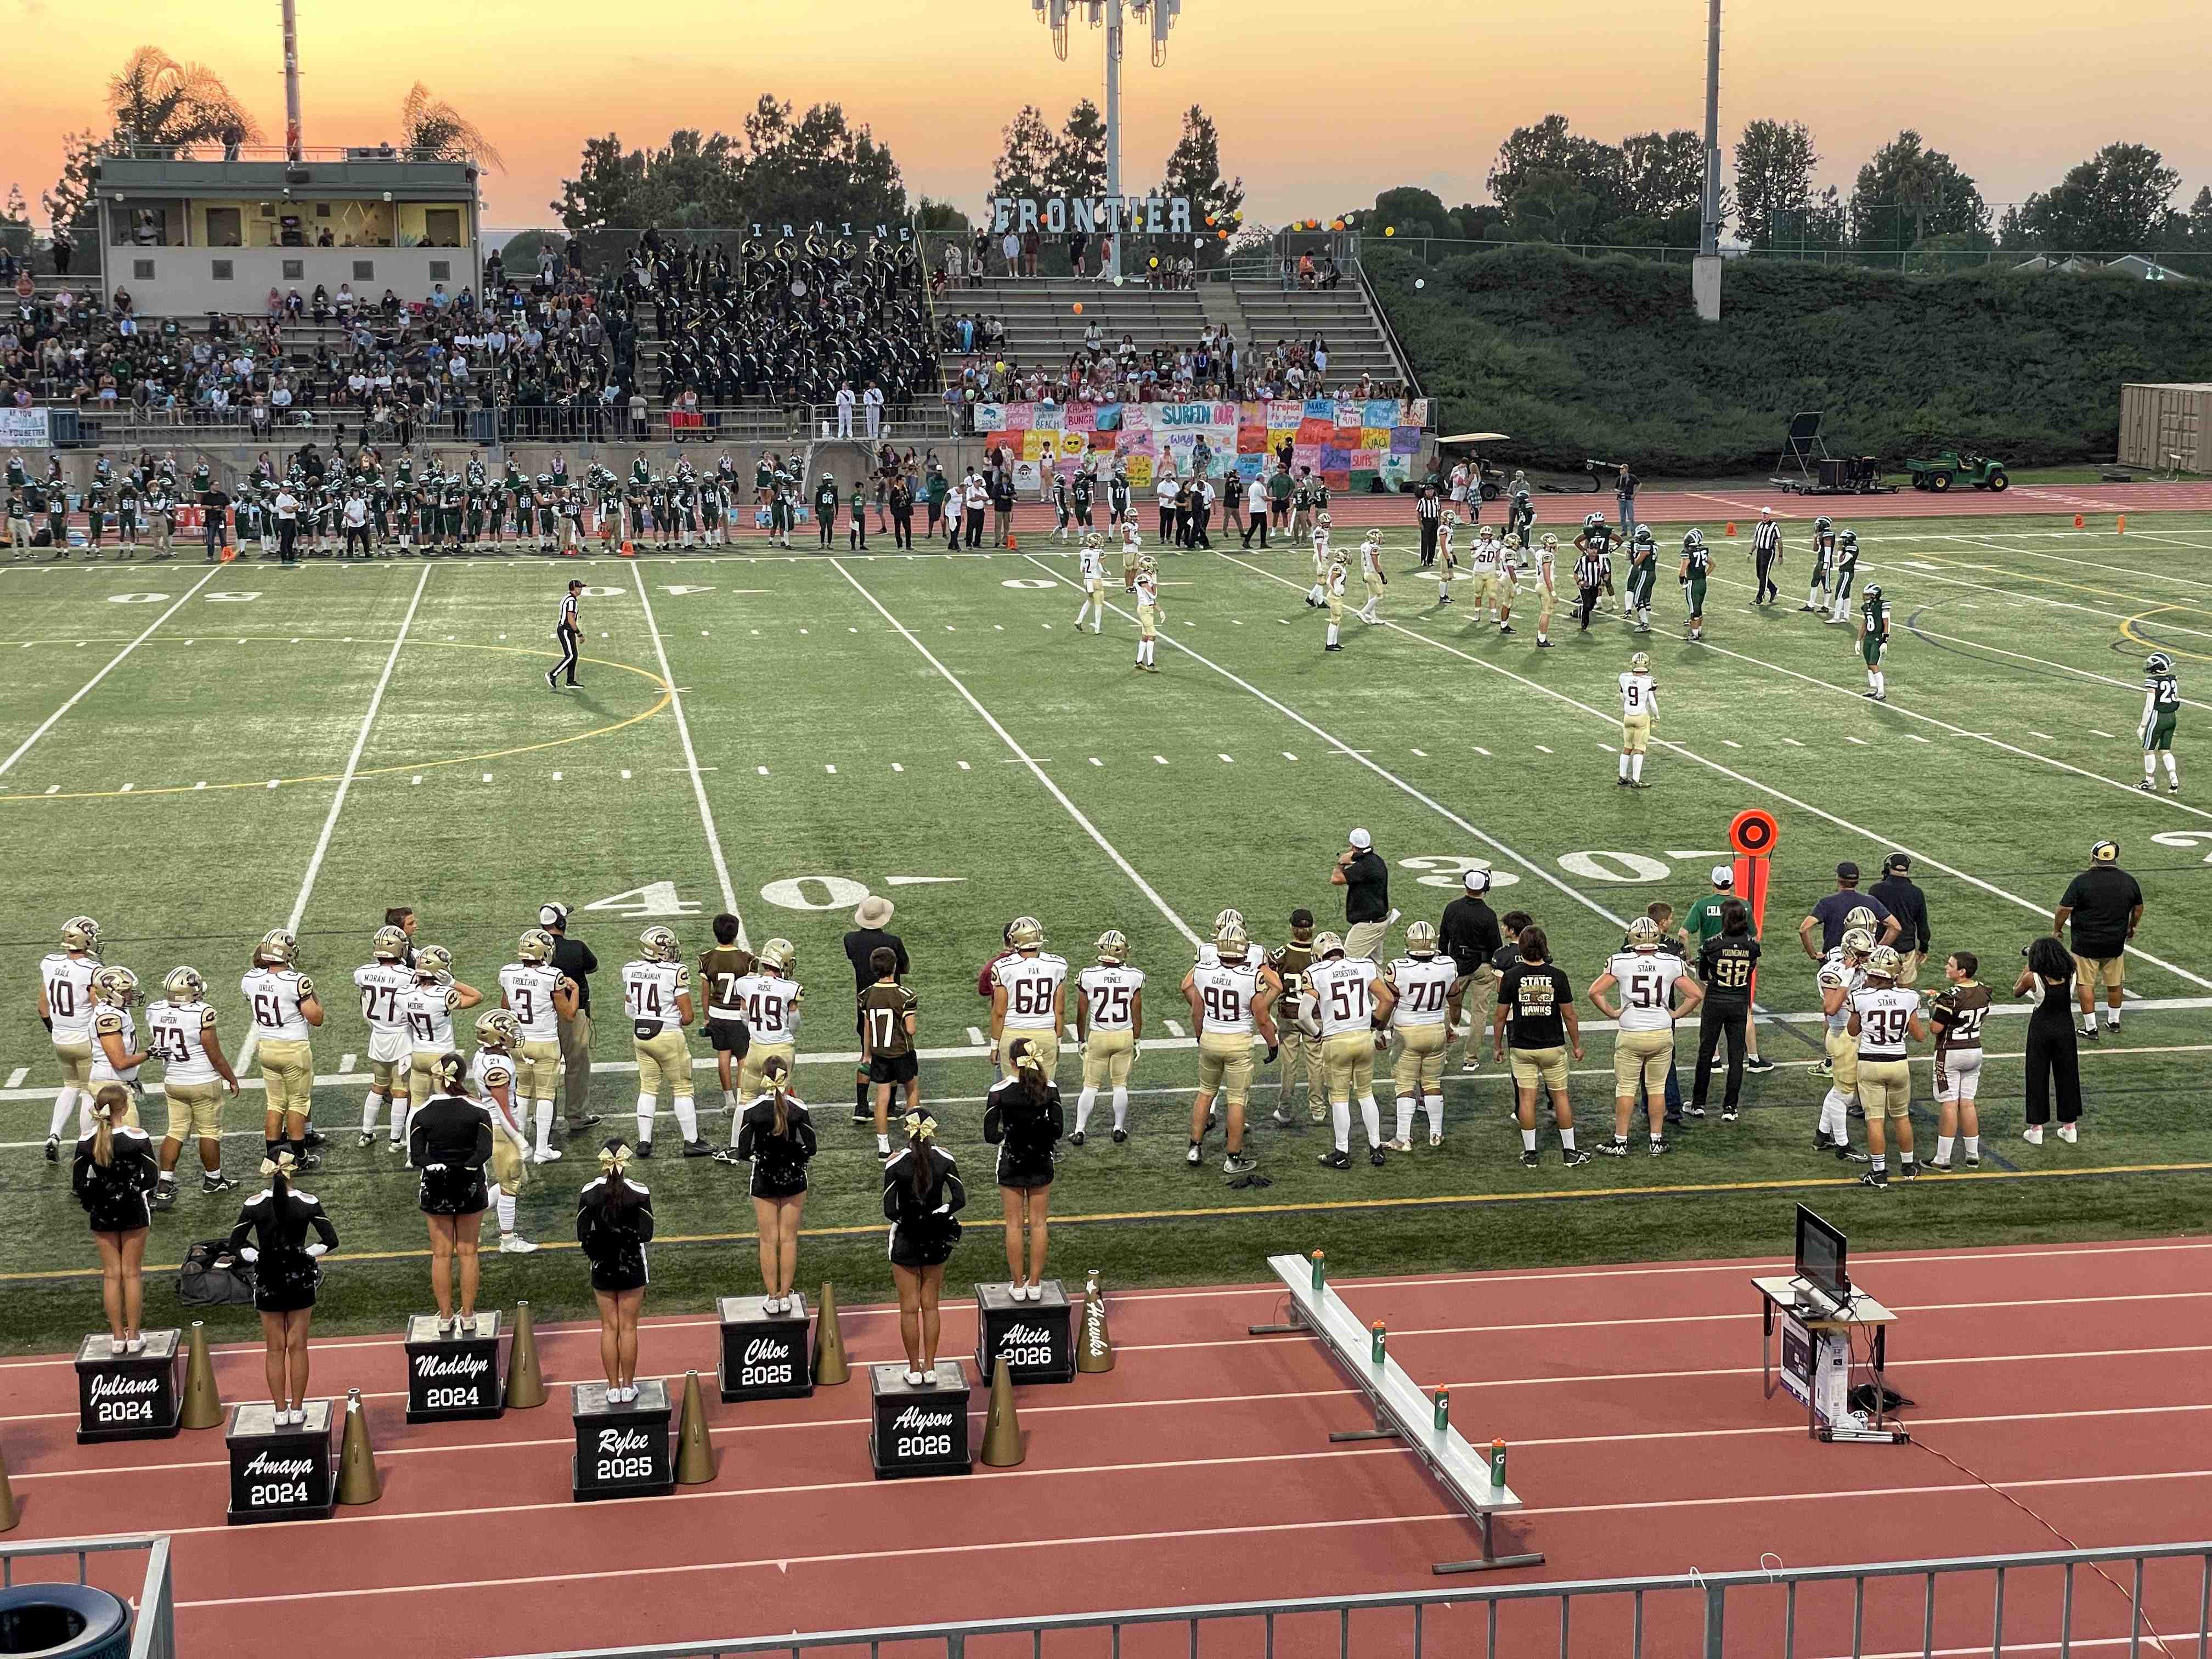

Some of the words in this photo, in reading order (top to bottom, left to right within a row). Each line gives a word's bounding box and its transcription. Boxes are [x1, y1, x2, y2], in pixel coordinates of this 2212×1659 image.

[994, 198, 1191, 233] FRONTIER
[1036, 420, 1059, 430] BEACH
[1068, 416, 1094, 426] BUNGA
[1162, 405, 1210, 425] SURFIN
[1214, 405, 1234, 426] OUR
[608, 500, 618, 509] 74
[653, 496, 663, 506] 27
[1085, 558, 1091, 573] 2
[1693, 550, 1708, 568] 75
[1628, 686, 1639, 707] 9
[2159, 680, 2178, 703] 23
[1722, 949, 1750, 958] YOUNGMAN
[54, 967, 70, 977] SKALA
[364, 974, 386, 983] MORAN
[388, 976, 396, 984] IV
[512, 977, 538, 986] TROCCHIO
[1028, 967, 1040, 975] PAK
[1212, 976, 1231, 987] GARCIA
[1332, 967, 1359, 980] ARDESTANI
[1520, 977, 1553, 988] STATE
[1717, 958, 1750, 987] 98
[49, 978, 75, 1017] 10
[259, 984, 274, 992] URIAS
[630, 982, 662, 1017] 74
[1015, 978, 1053, 1014] 68
[1330, 978, 1364, 1021] 57
[1408, 981, 1446, 1012] 70
[1632, 975, 1662, 1008] 51
[254, 994, 284, 1027] 61
[361, 985, 397, 1022] 27
[407, 1001, 425, 1011] MOORE
[515, 989, 534, 1025] 3
[749, 994, 782, 1031] 49
[1094, 987, 1129, 1022] 25
[1204, 986, 1239, 1022] 99
[1521, 1006, 1551, 1016] HAWKS
[1878, 998, 1898, 1007] STARK
[408, 1012, 434, 1042] 17
[869, 1008, 894, 1048] 17
[1867, 1009, 1907, 1045] 39
[1951, 1006, 1989, 1041] 25
[153, 1025, 190, 1062] 73
[998, 1323, 1052, 1346] Alicia
[1086, 1299, 1109, 1358] Hawks
[1376, 1334, 1385, 1344] G
[744, 1338, 789, 1365] Chloe
[1002, 1346, 1052, 1365] 2026
[415, 1353, 488, 1379] Madelyn
[742, 1364, 792, 1386] 2025
[90, 1374, 160, 1406] Juliana
[426, 1386, 479, 1408] 2024
[99, 1400, 153, 1423] 2024
[1438, 1399, 1448, 1409] G
[892, 1405, 953, 1434] Alyson
[597, 1429, 649, 1457] Rylee
[898, 1434, 951, 1457] 2026
[243, 1451, 314, 1481] Amaya
[597, 1456, 653, 1480] 2025
[1495, 1454, 1505, 1464] G
[251, 1482, 308, 1505] 2024
